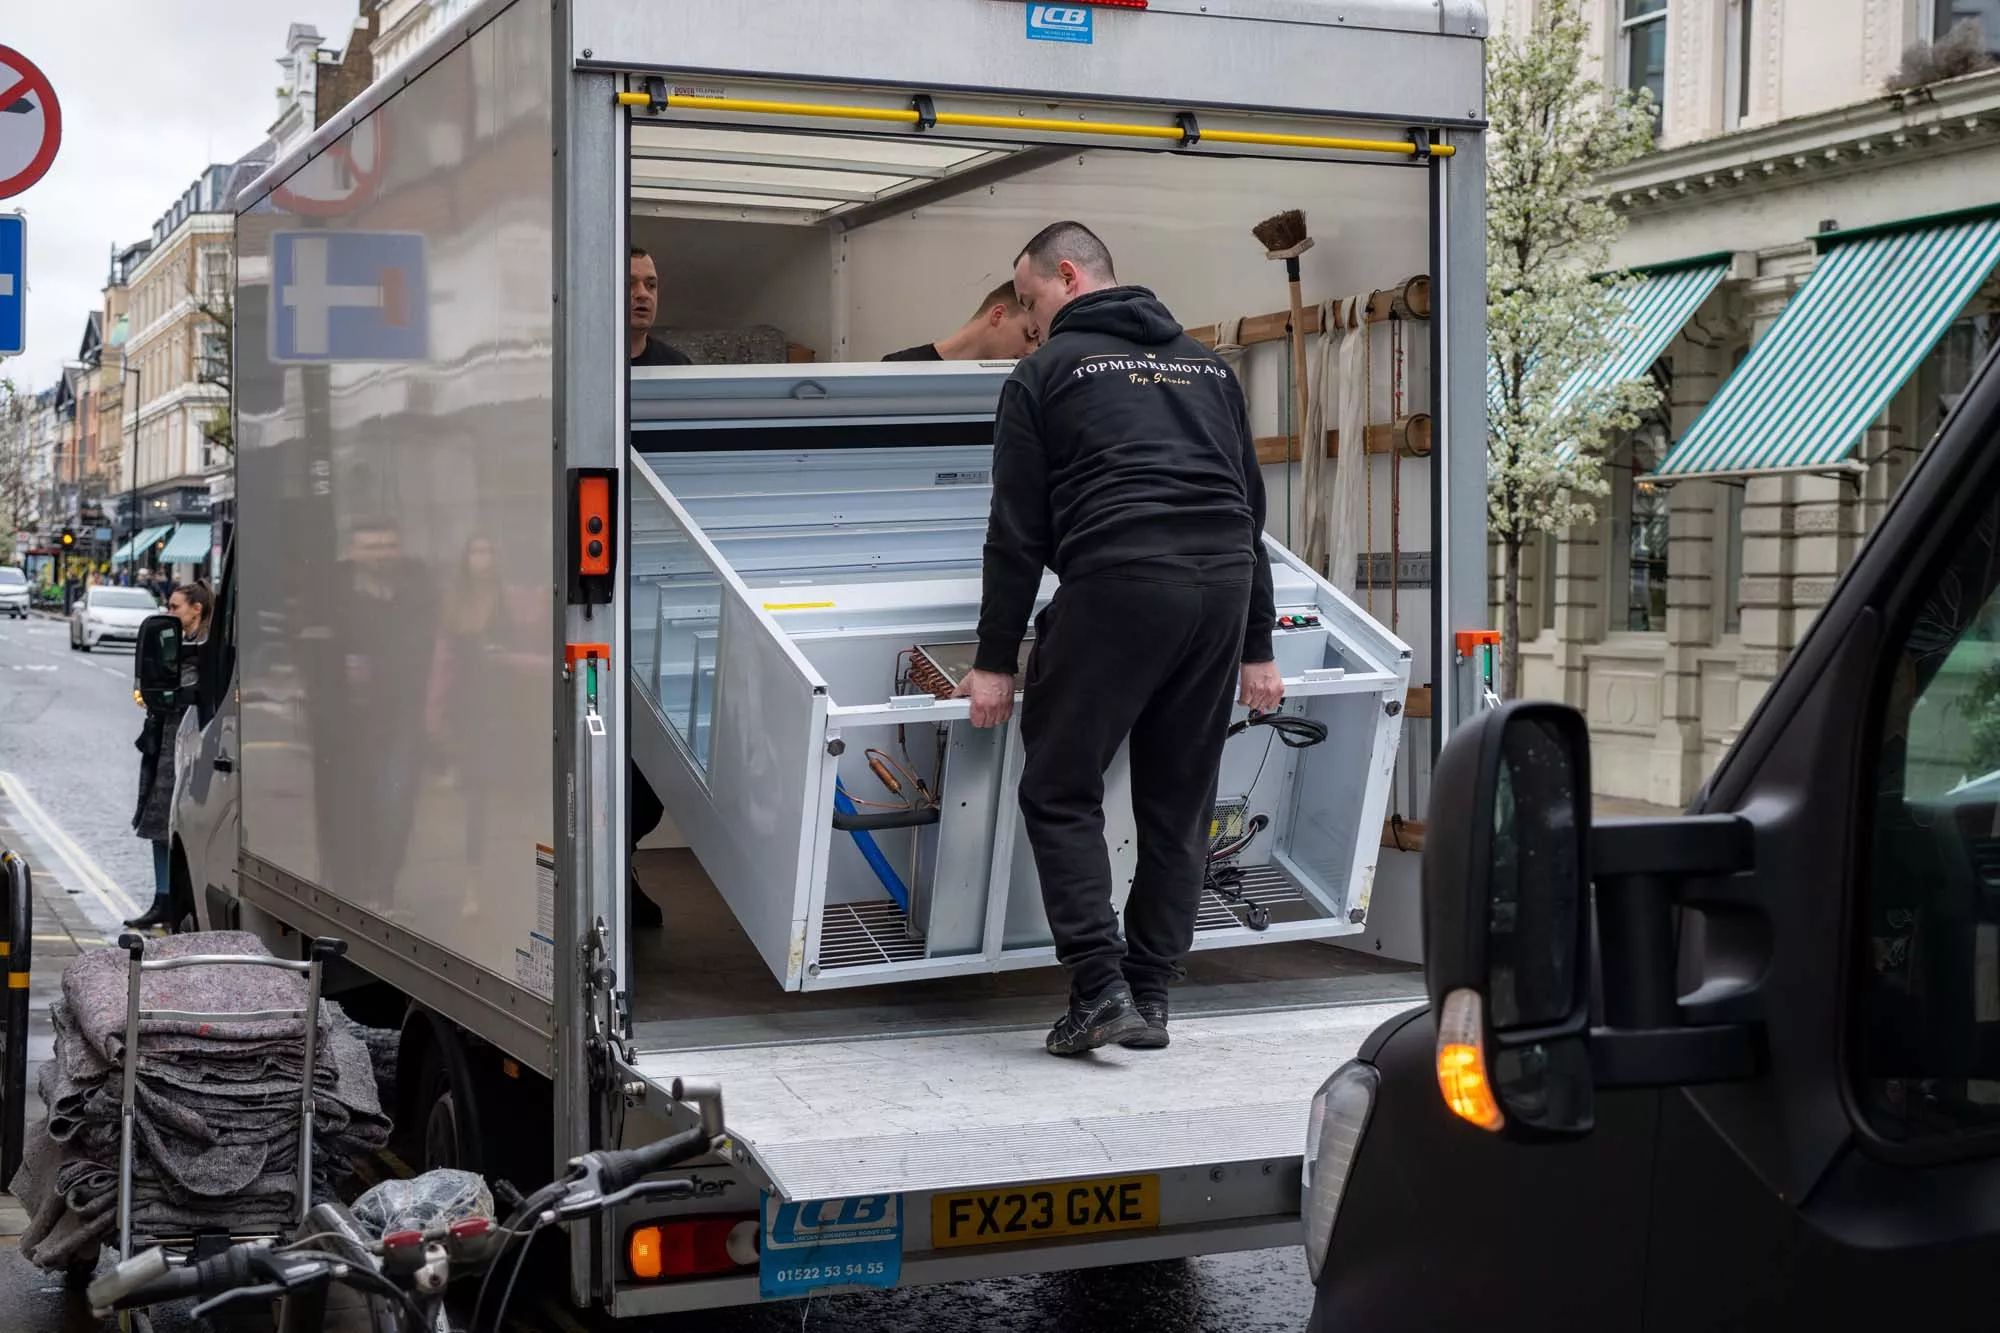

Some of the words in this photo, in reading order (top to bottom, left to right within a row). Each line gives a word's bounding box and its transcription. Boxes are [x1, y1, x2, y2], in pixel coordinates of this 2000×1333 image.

[1031, 6, 1088, 31] LCB
[1129, 373, 1149, 385] Top
[1154, 372, 1192, 385] Service
[949, 1191, 1054, 1238] FX23
[1066, 1183, 1142, 1226] GXE
[777, 1267, 820, 1282] 01522
[824, 1265, 841, 1278] 53
[846, 1263, 862, 1275] 54
[867, 1262, 884, 1274] 55
